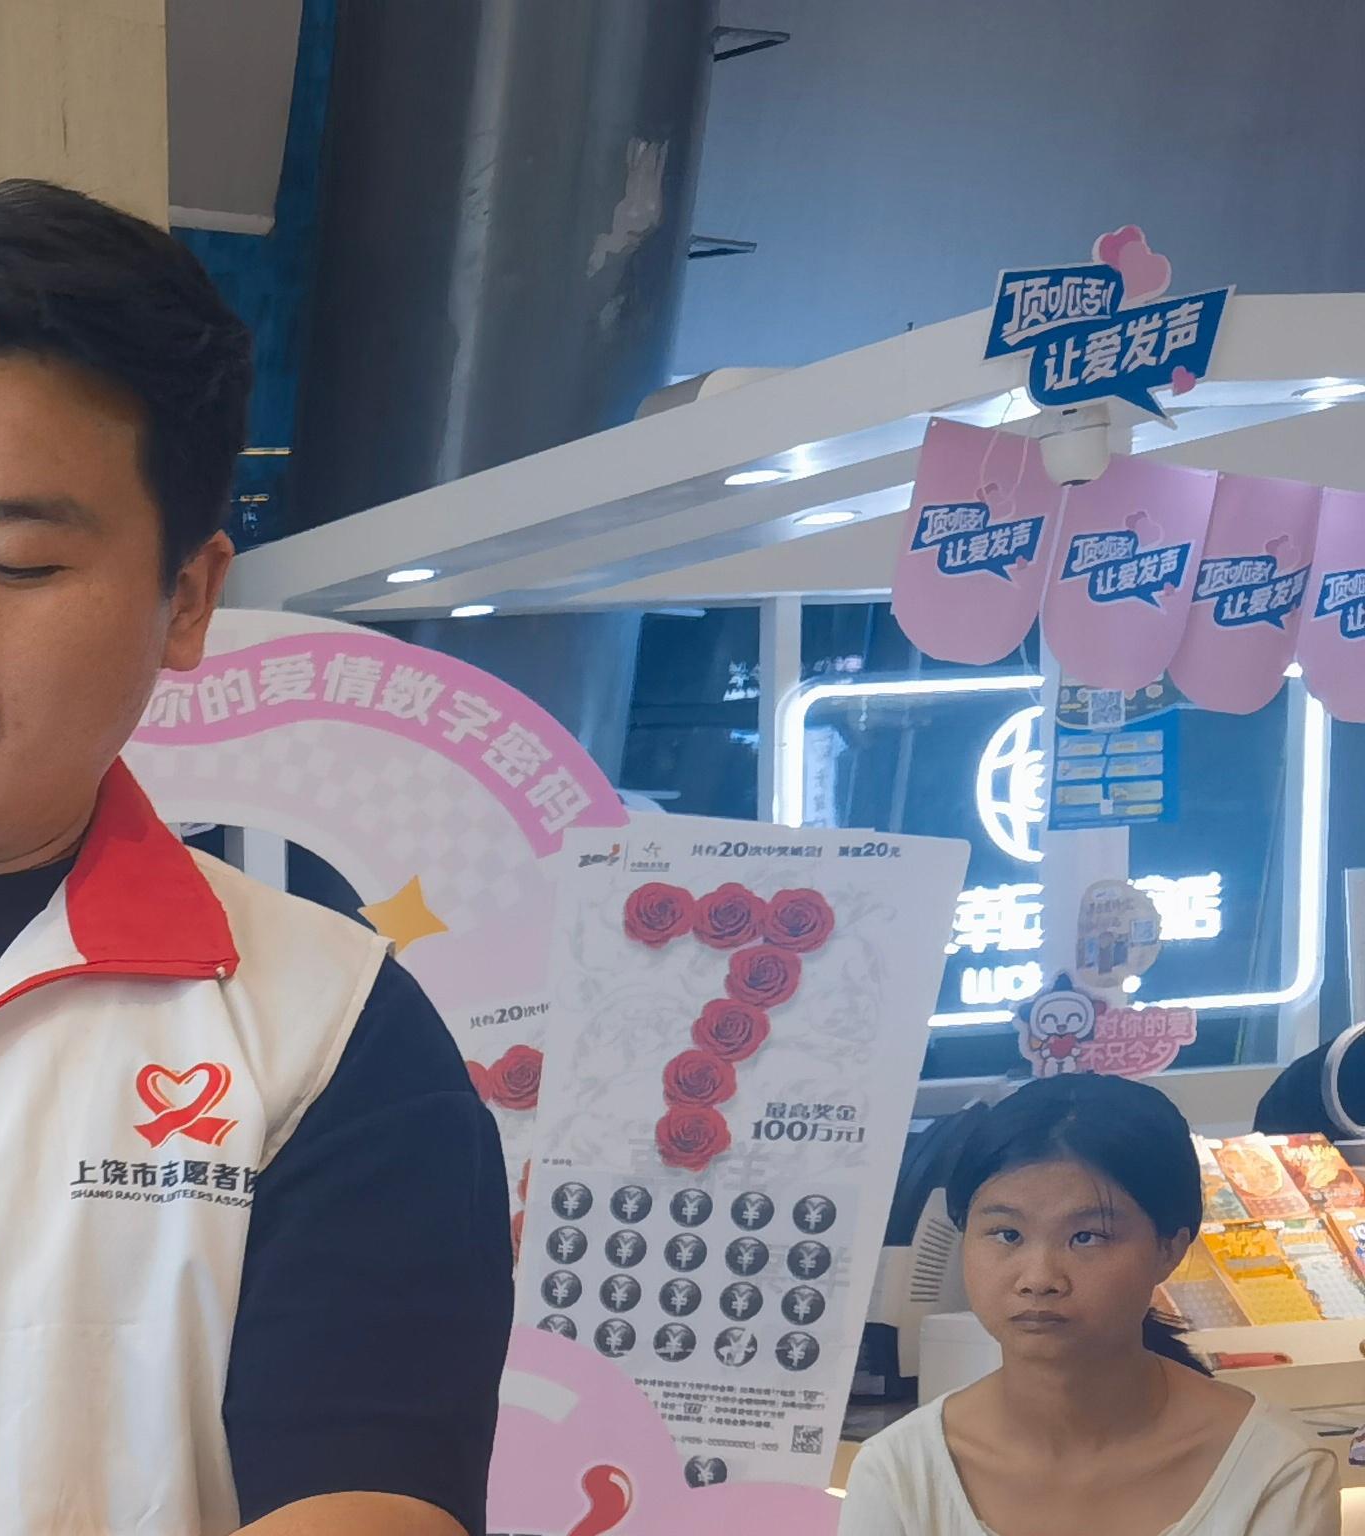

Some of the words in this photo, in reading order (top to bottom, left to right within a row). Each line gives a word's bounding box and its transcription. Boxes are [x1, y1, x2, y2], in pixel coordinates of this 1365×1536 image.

[1001, 277, 1115, 345] 顶呱刮
[1043, 301, 1204, 391] 让爱发声
[921, 506, 984, 543] 顶呱刮
[945, 524, 1036, 568] 让爱发声
[1072, 536, 1135, 573] 顶呱刮
[1095, 549, 1179, 595] 让爱发声
[1197, 561, 1273, 597] 顶呱刮
[765, 1102, 857, 1121] 最高奖金
[115, 1190, 141, 1201] RAO
